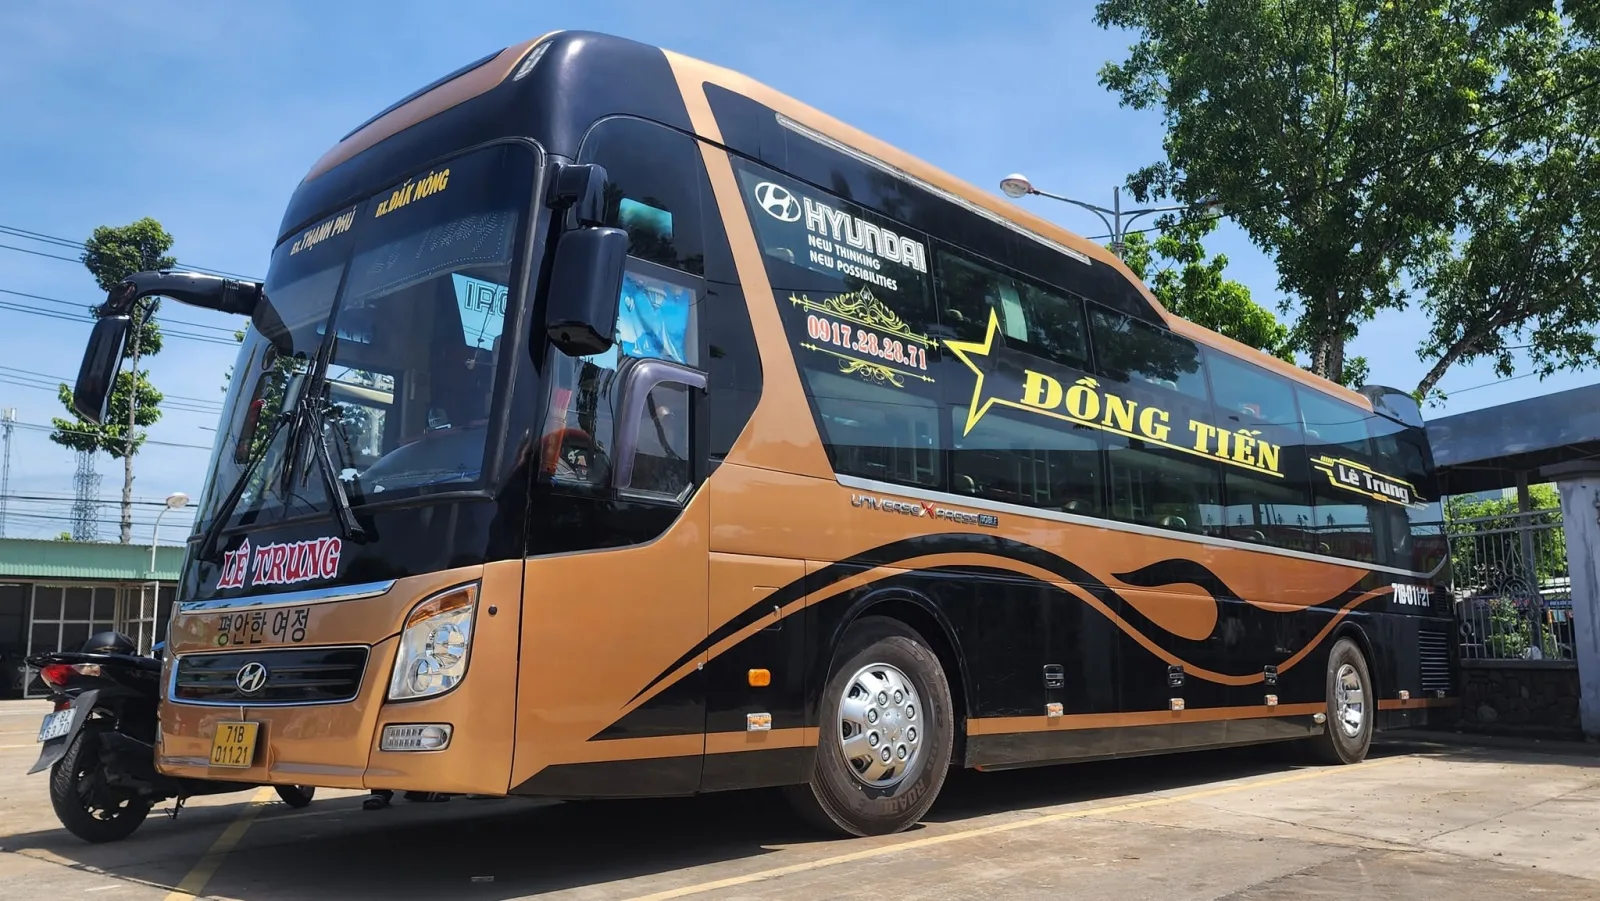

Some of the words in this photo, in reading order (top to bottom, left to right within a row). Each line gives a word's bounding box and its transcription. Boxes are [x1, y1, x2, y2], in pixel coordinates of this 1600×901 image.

[412, 168, 450, 202] NÔNG
[331, 205, 357, 237] PHÚ
[803, 196, 928, 273] HYUNDAI
[807, 234, 833, 253] NEW
[834, 243, 881, 270] THINKING
[809, 250, 834, 268] NEW
[837, 261, 898, 291] POSSIBILITIES
[807, 314, 927, 370] 0917.28.28.71
[1020, 369, 1171, 442] ĐỒNG
[1188, 419, 1281, 472] TIẾN
[1338, 464, 1360, 486] Lê
[1363, 472, 1410, 504] Trung
[216, 537, 250, 590] LÊ
[252, 536, 342, 586] TRUNG
[217, 612, 267, 646] 평안한
[272, 607, 310, 643] 여정
[226, 725, 245, 743] 71B
[214, 745, 248, 764] 011.21
